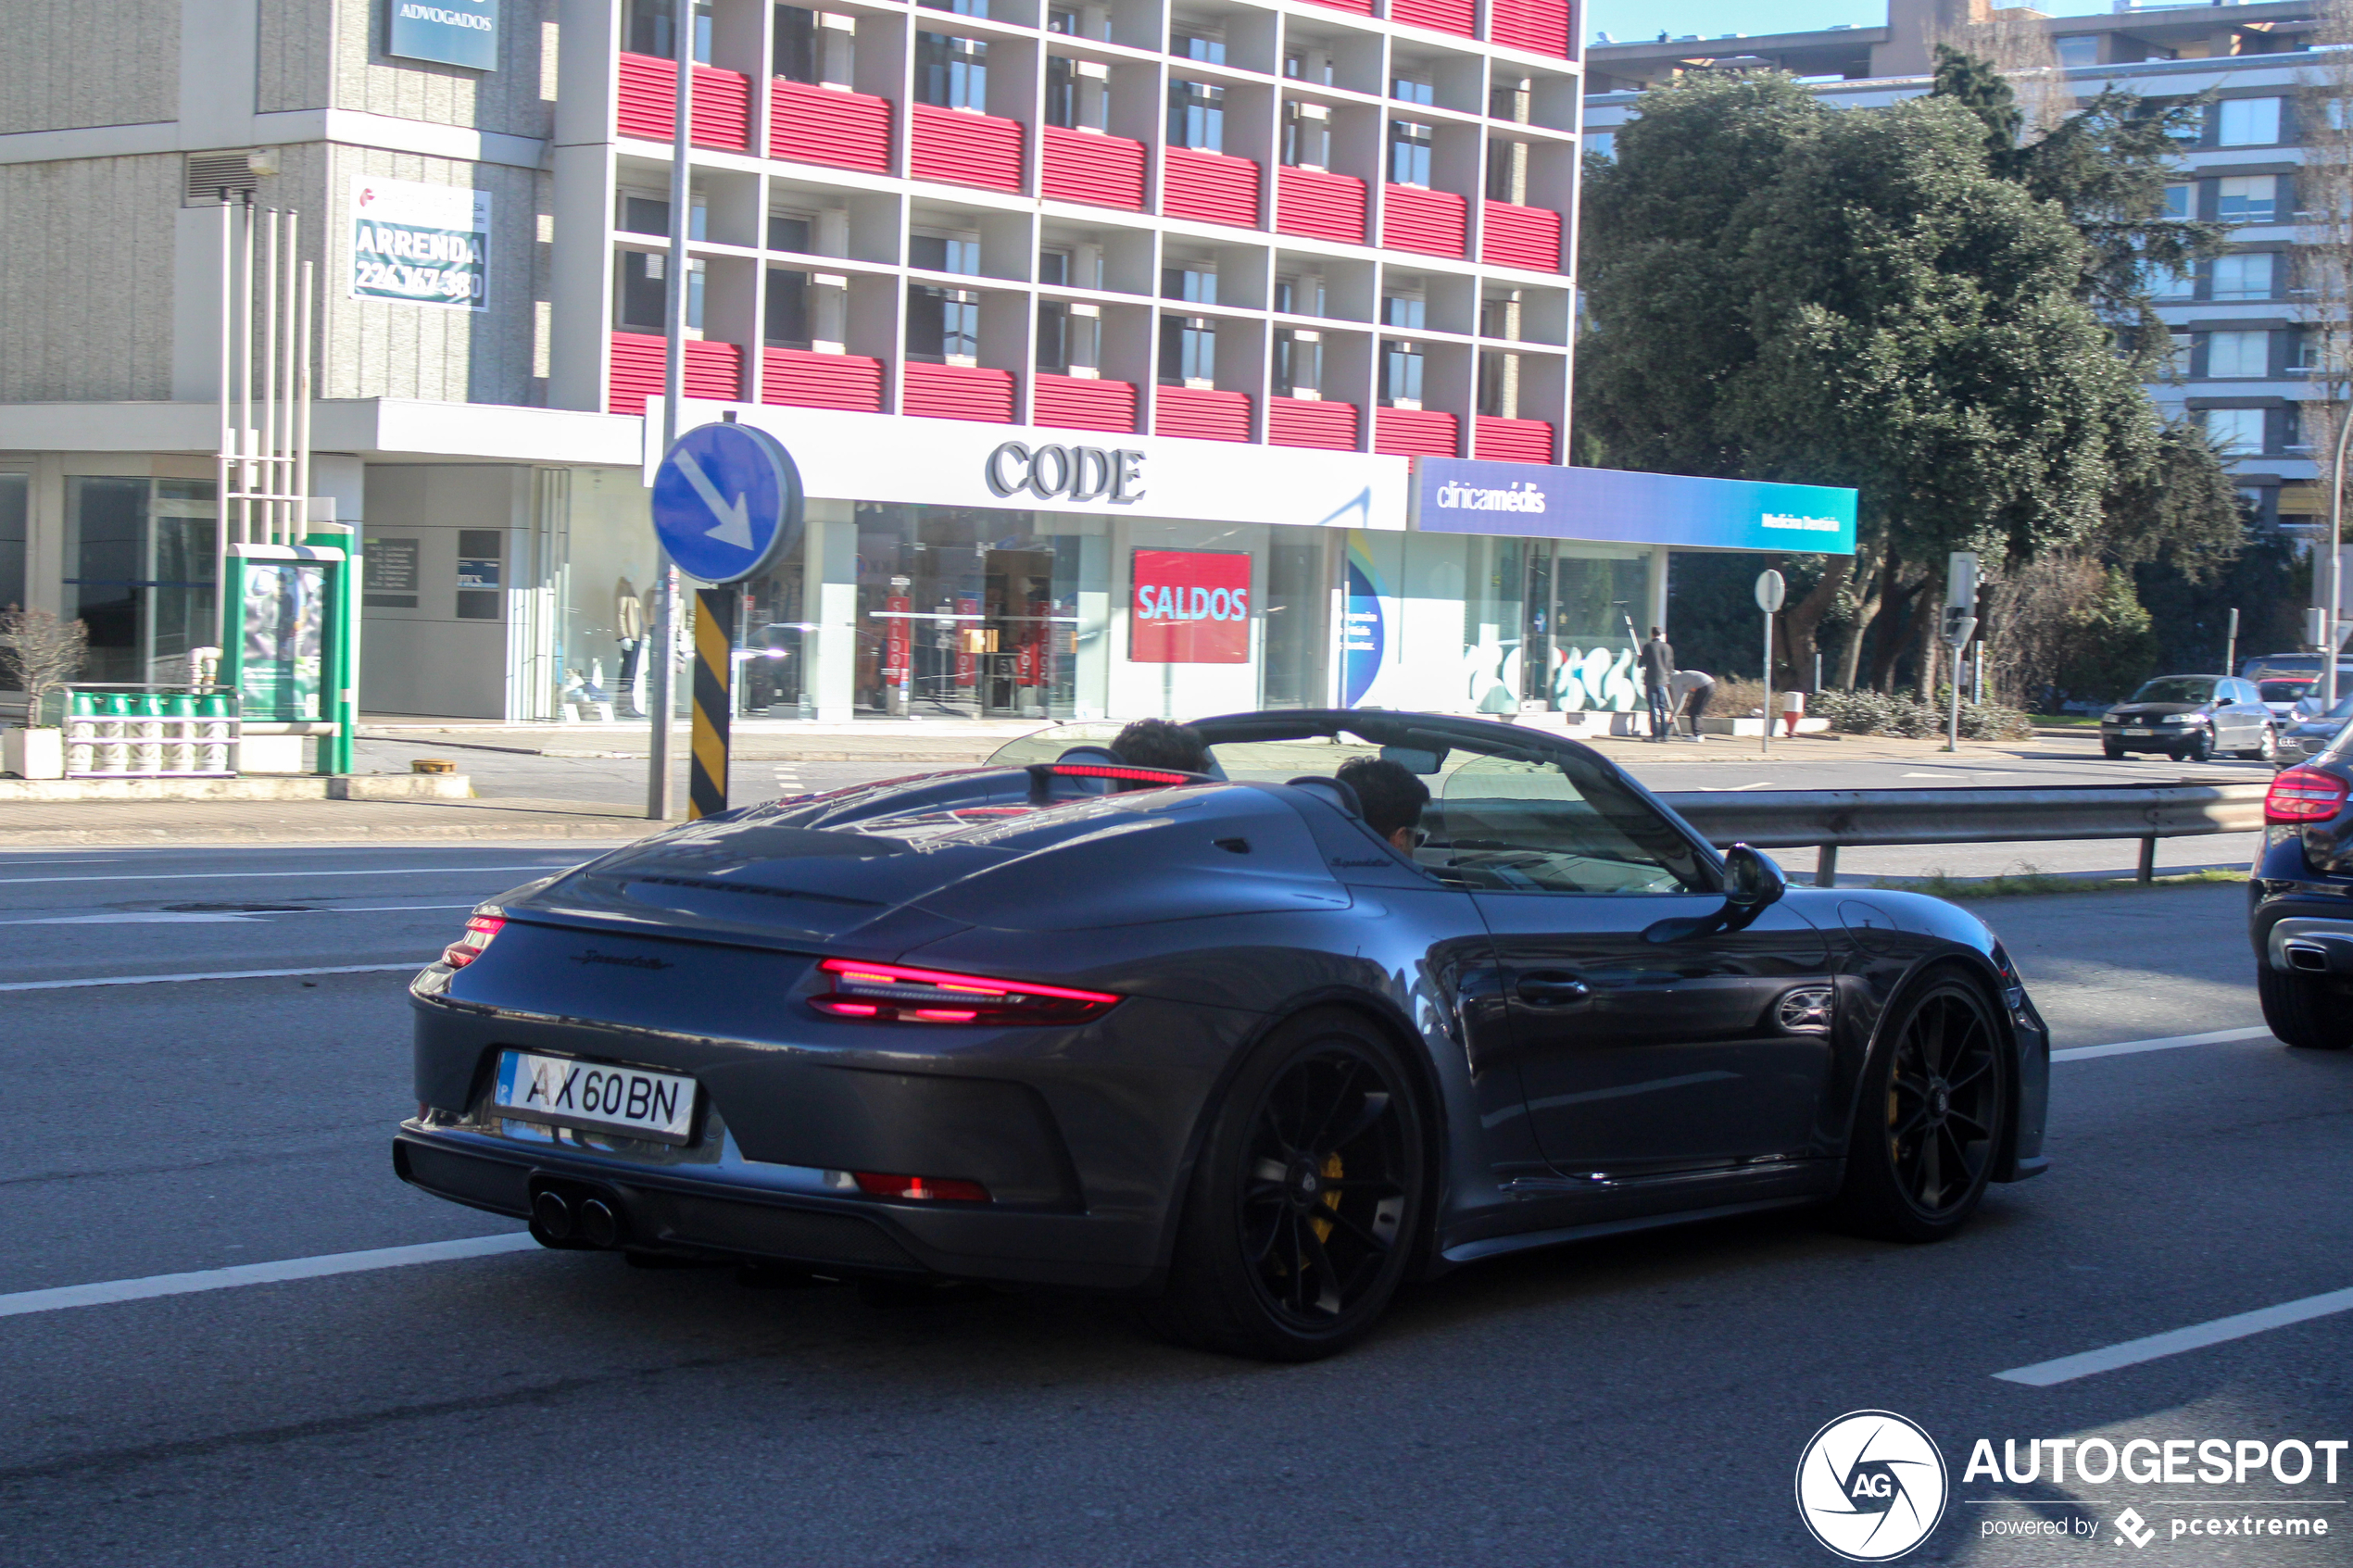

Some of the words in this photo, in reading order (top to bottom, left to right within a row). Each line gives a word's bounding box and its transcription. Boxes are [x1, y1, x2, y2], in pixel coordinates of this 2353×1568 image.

[399, 4, 493, 31] ADVOGADOS
[357, 225, 484, 265] ARRENDA
[985, 440, 1147, 505] CODE
[1138, 584, 1248, 621] SALDOS
